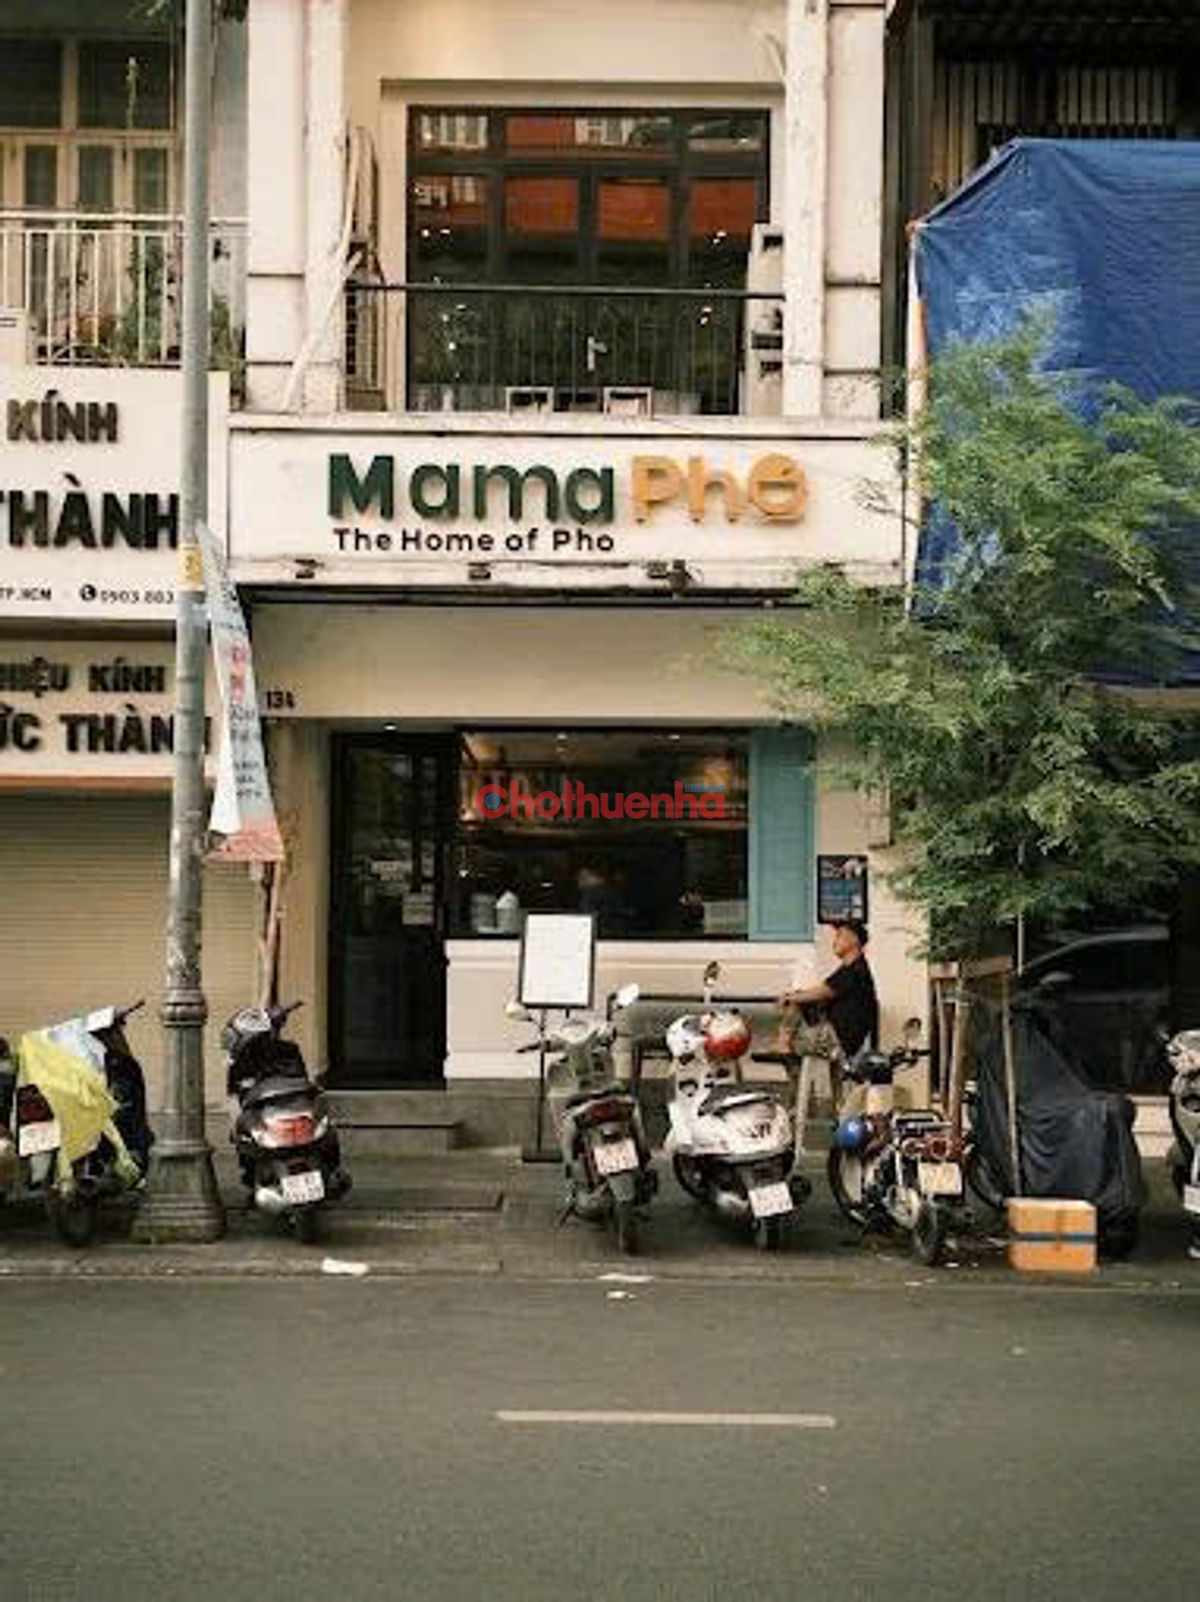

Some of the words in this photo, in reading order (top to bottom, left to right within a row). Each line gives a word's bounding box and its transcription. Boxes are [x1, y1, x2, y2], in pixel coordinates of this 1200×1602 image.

[7, 388, 119, 444] KÍNH
[0, 473, 180, 549] HÀNH
[328, 453, 615, 525] Mama
[333, 527, 392, 551] The
[401, 528, 495, 551] Home
[504, 527, 539, 551] of
[552, 528, 614, 552] Pho
[88, 656, 166, 693] KÍNH
